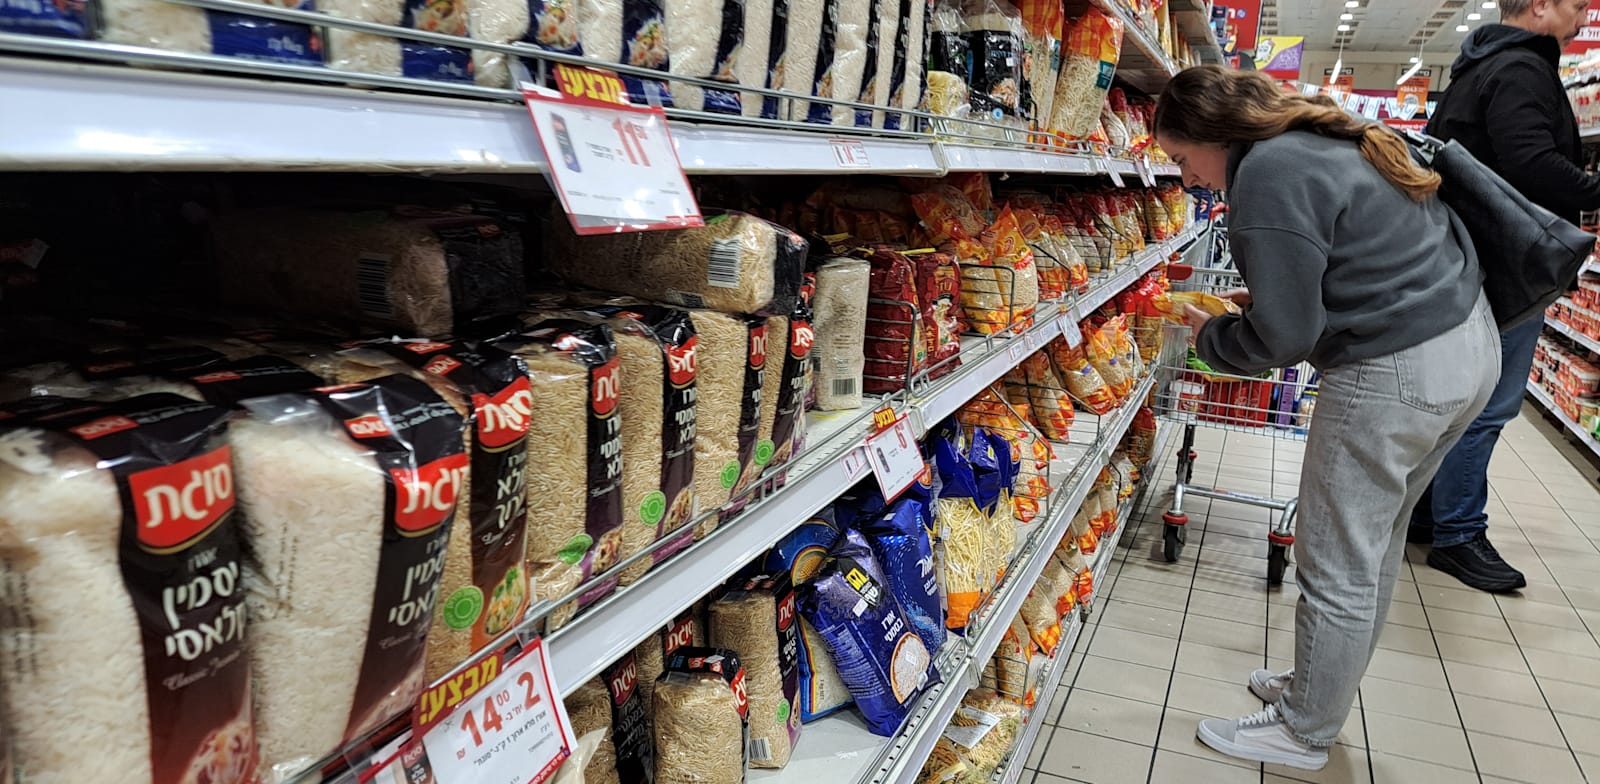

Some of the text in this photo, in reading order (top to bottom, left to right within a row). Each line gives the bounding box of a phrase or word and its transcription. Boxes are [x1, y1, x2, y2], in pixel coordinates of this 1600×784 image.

[143, 463, 232, 528] סוגת
[163, 561, 239, 630] יסמין
[165, 601, 249, 661] קלאסי
[668, 619, 694, 651] סוגת
[881, 610, 896, 630] אורז
[884, 617, 904, 642] בסמטי
[419, 655, 498, 726] מבצע!
[517, 671, 541, 710] 2
[613, 662, 637, 698] סוגת
[461, 696, 503, 747] 14
[496, 689, 510, 707] 00
